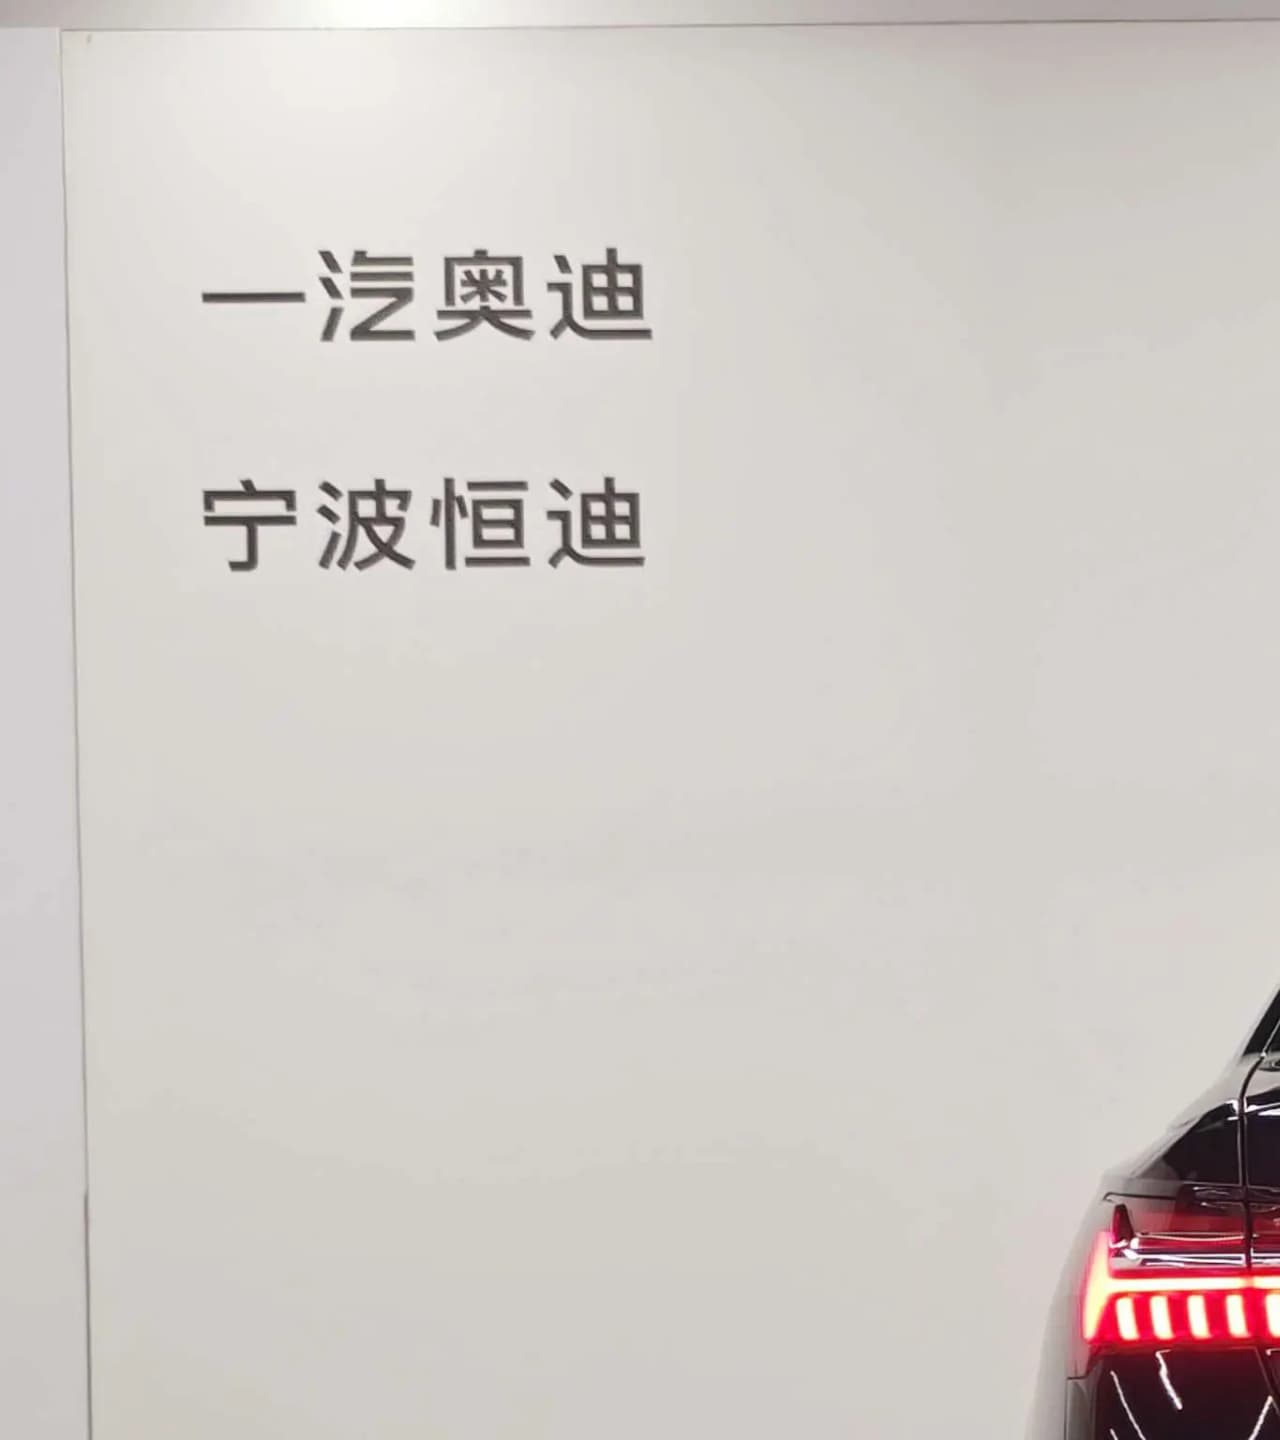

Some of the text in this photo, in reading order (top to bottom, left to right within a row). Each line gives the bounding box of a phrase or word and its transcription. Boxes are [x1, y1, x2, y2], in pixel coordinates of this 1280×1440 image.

[202, 247, 652, 341] 一汽奥迪
[203, 476, 645, 571] 宁波恒迪
